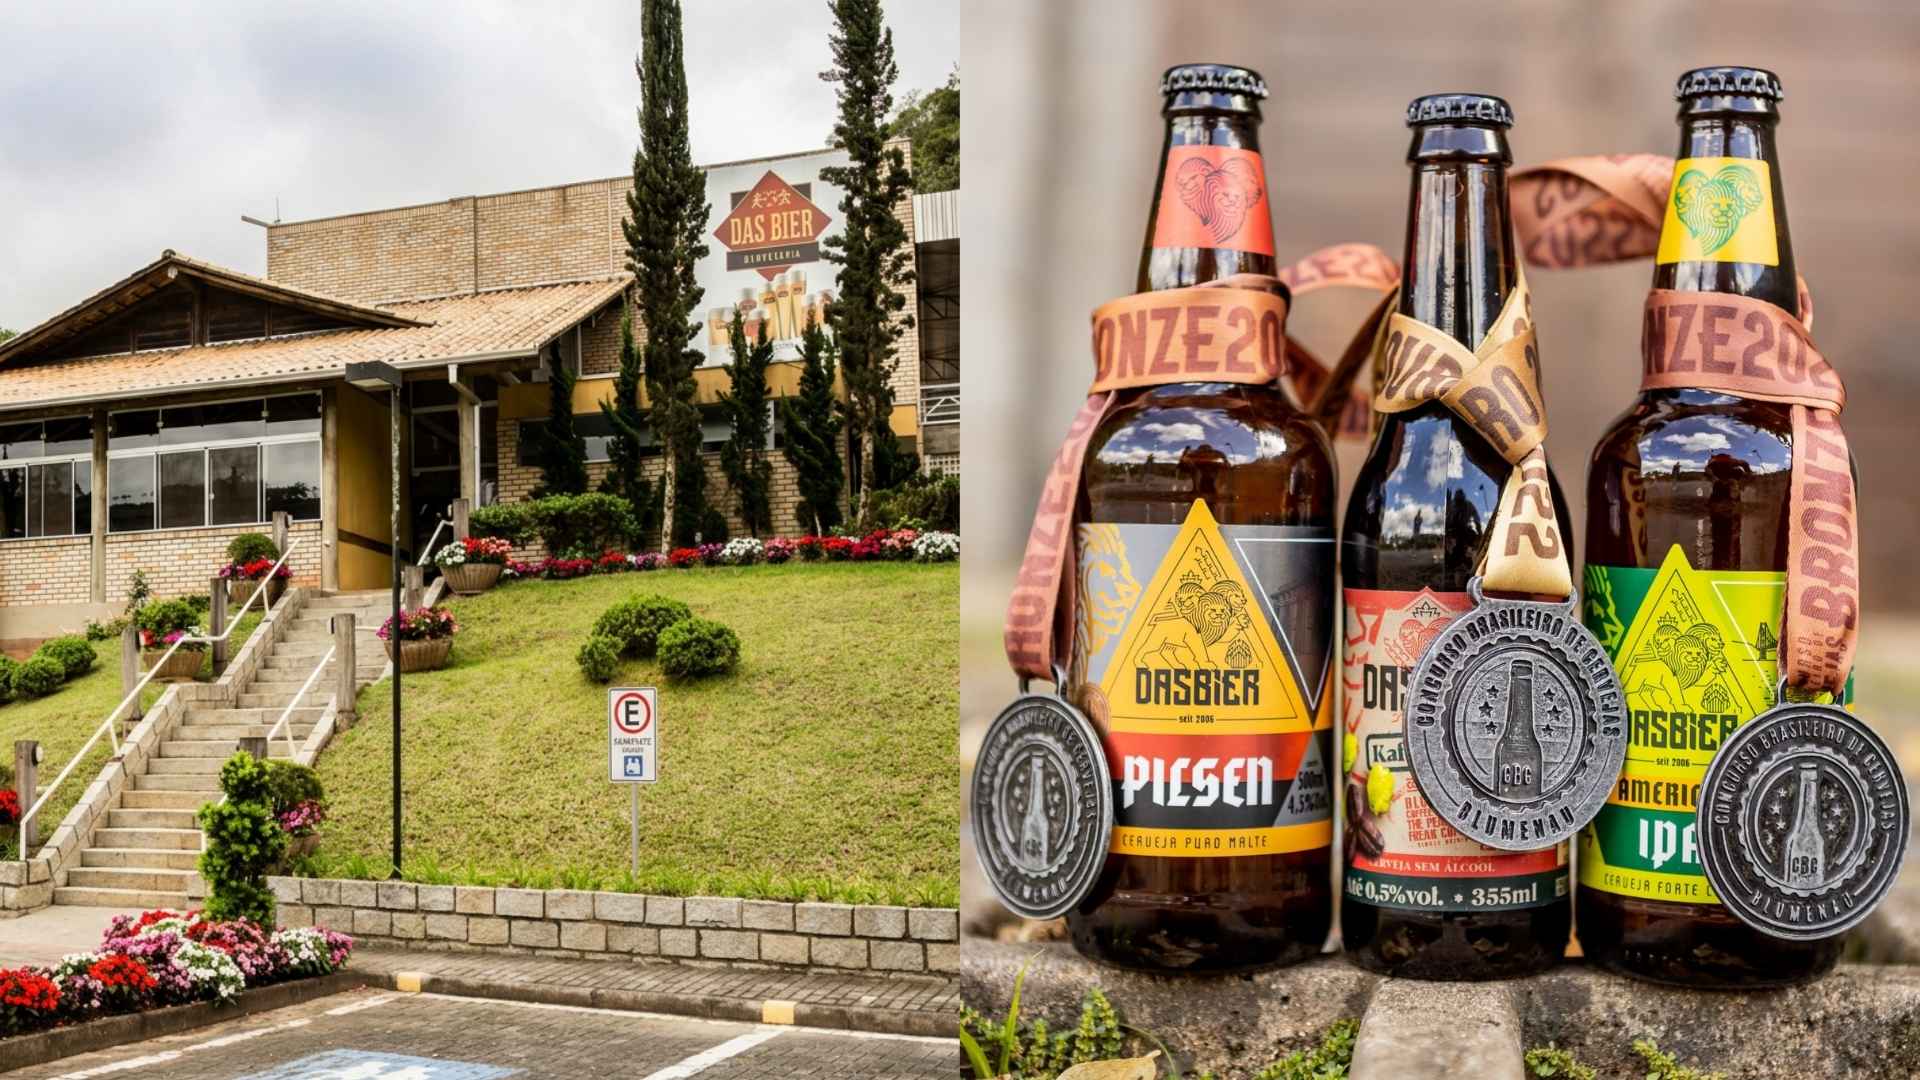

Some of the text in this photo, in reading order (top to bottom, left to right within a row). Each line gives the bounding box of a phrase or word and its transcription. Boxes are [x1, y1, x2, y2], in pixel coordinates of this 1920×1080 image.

[730, 209, 813, 245] DAS BIER
[1416, 608, 1621, 737] CONCURSO BRASILEIRO DE CERVEJAS
[625, 700, 639, 726] E
[1179, 715, 1193, 723] seit
[1656, 757, 1690, 767] seit 2006
[1121, 755, 1273, 809] PILSEN
[1714, 745, 1759, 824] CONCURSO
[1759, 720, 1846, 749] BRASILEIRO
[1864, 753, 1896, 831] CERVEJAS
[1458, 801, 1575, 841] BLUMENAU
[1122, 835, 1267, 849] CERVEJA PURO MALTE
[1368, 859, 1411, 871] ERVEJA
[1414, 862, 1439, 872] SEM
[1791, 856, 1818, 874] CBC
[1471, 882, 1537, 905] 355ml
[1604, 873, 1650, 891] CERVEJA
[1657, 881, 1698, 896] FORTE
[1751, 889, 1854, 922] BLUMENAU
